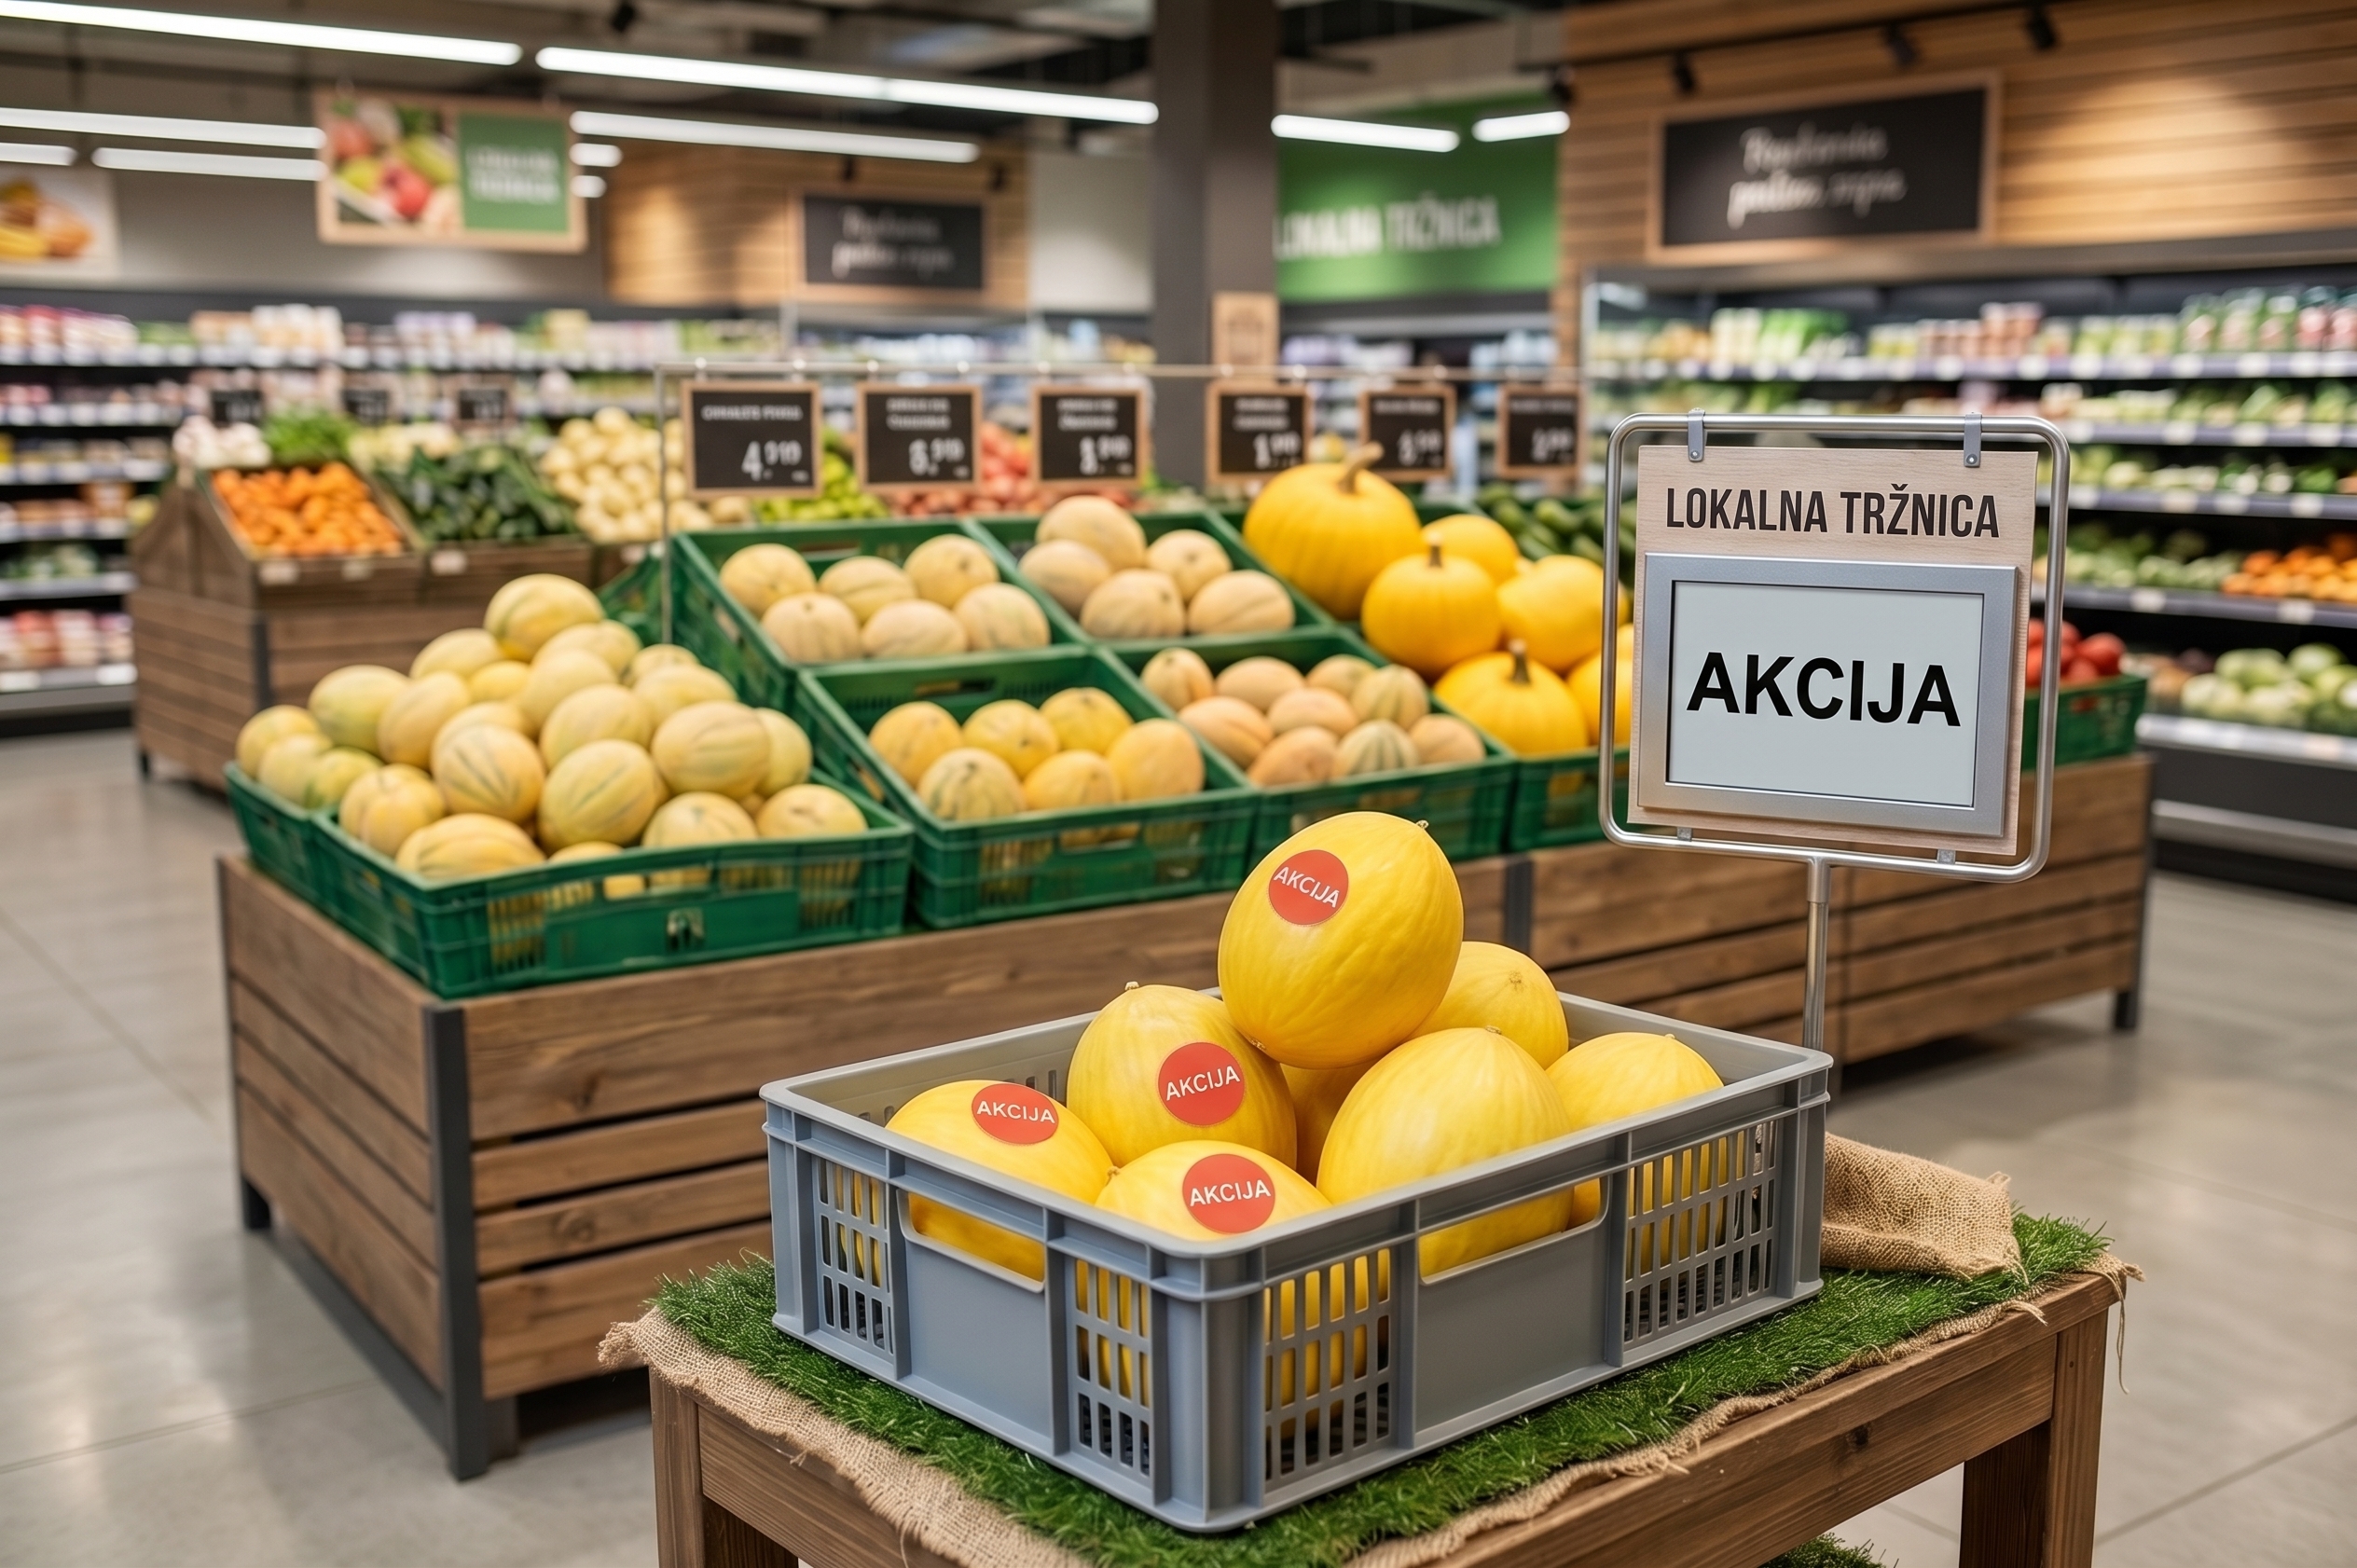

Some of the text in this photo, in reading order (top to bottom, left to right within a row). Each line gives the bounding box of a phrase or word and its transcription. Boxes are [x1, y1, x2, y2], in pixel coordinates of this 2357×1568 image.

[1666, 483, 2000, 538] LOKALNA TRŽNICA
[1686, 652, 1962, 727] AKCIJA
[1273, 866, 1340, 909] AKCIJA
[1165, 1065, 1241, 1101] AKCIJA
[976, 1100, 1055, 1124] AKCIJA
[1189, 1178, 1272, 1207] AKCIJA
